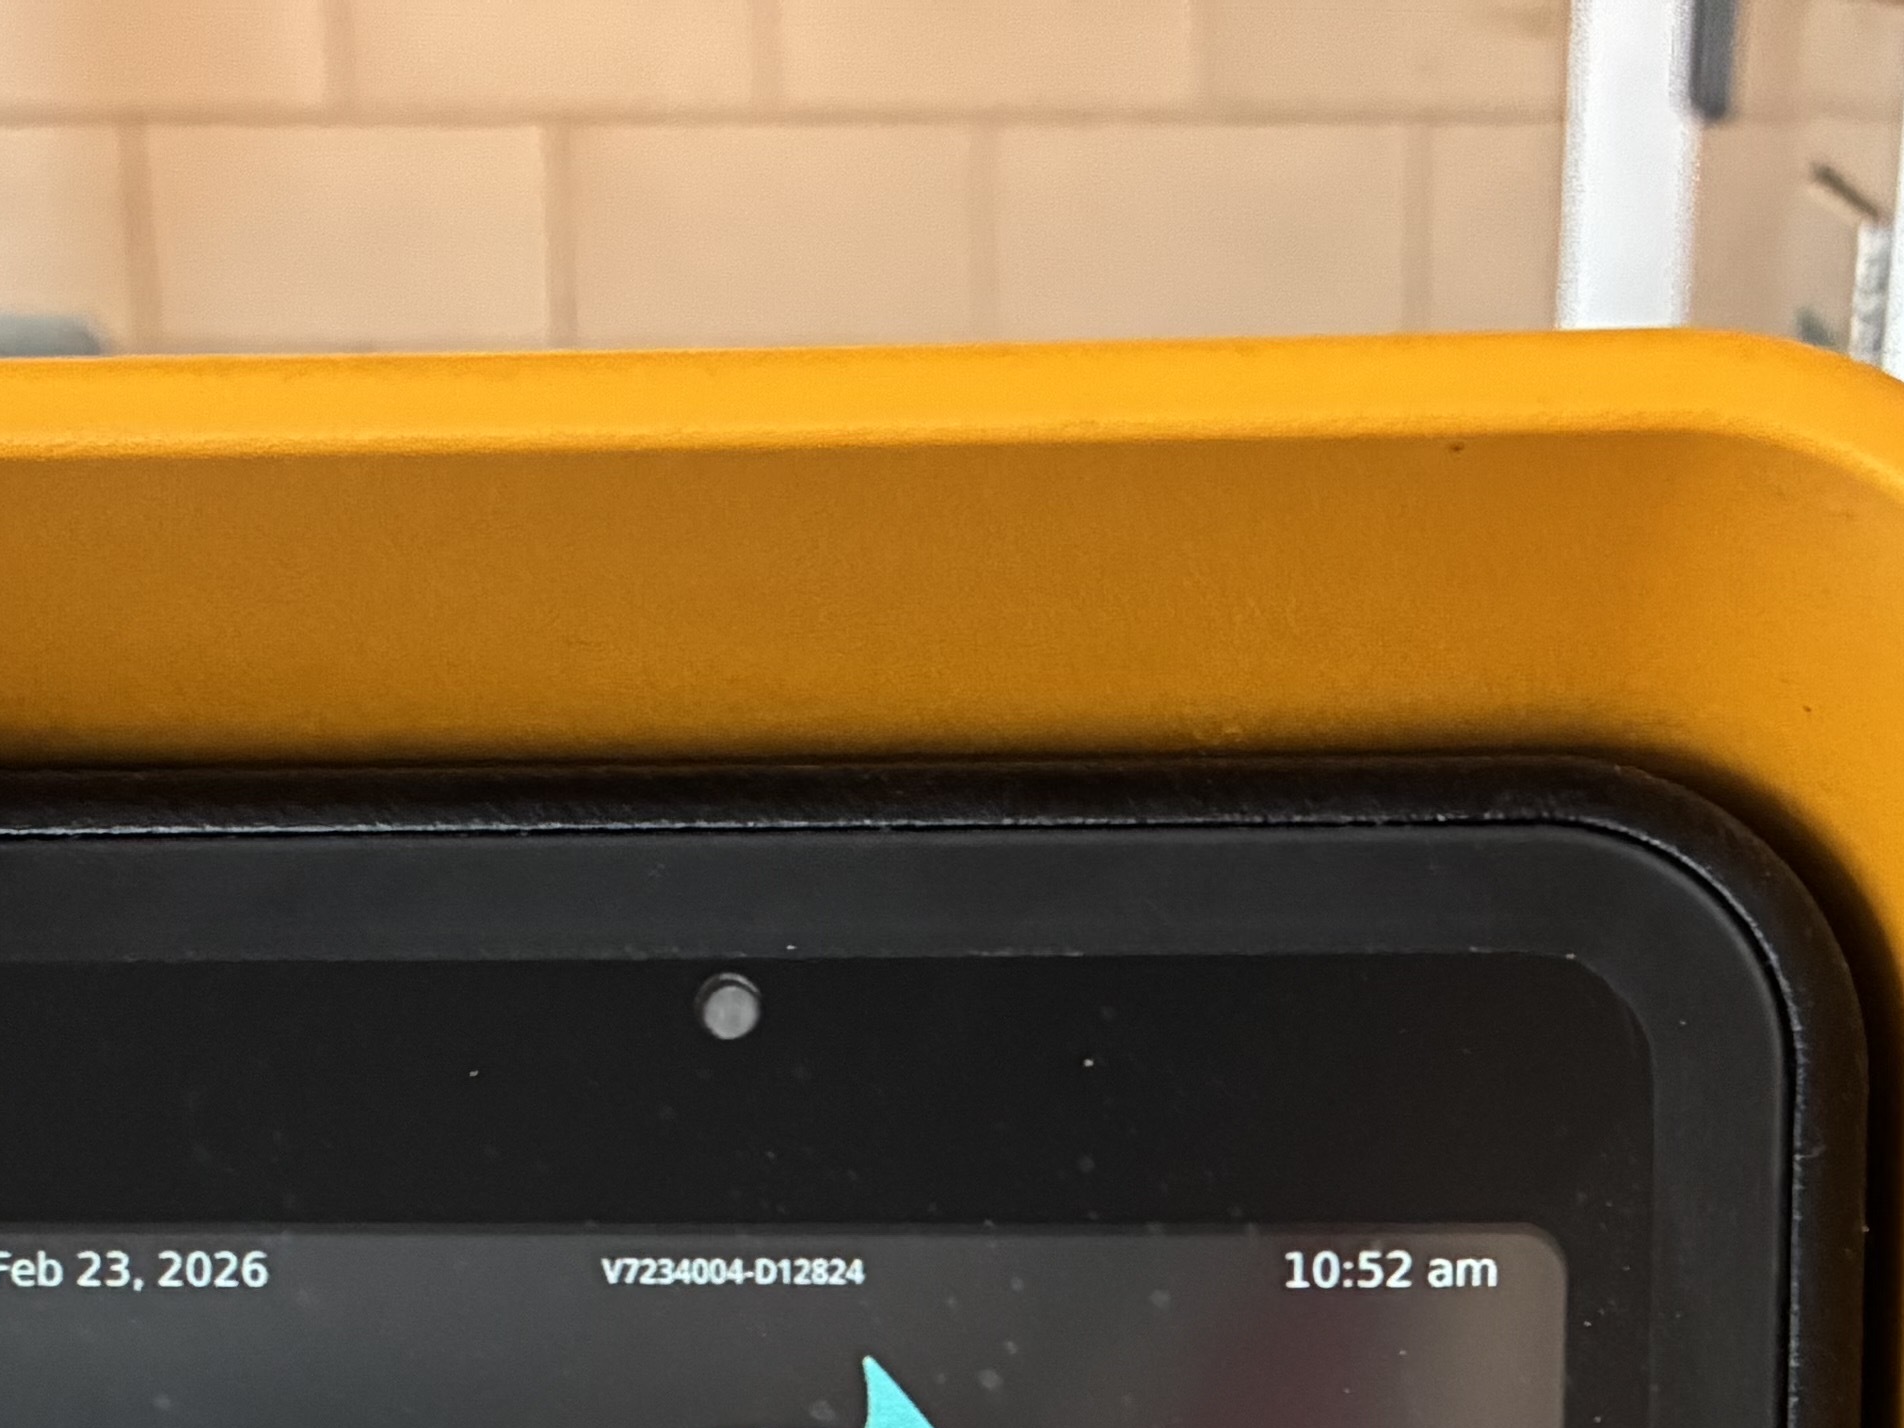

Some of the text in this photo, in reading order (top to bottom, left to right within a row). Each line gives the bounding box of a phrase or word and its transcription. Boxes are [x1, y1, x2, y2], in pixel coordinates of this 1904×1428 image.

[75, 1249, 145, 1293] 23,
[156, 1249, 269, 1288] 2026
[601, 1256, 866, 1286] V7234004-D12824
[1284, 1248, 1498, 1289] 10:52 am
